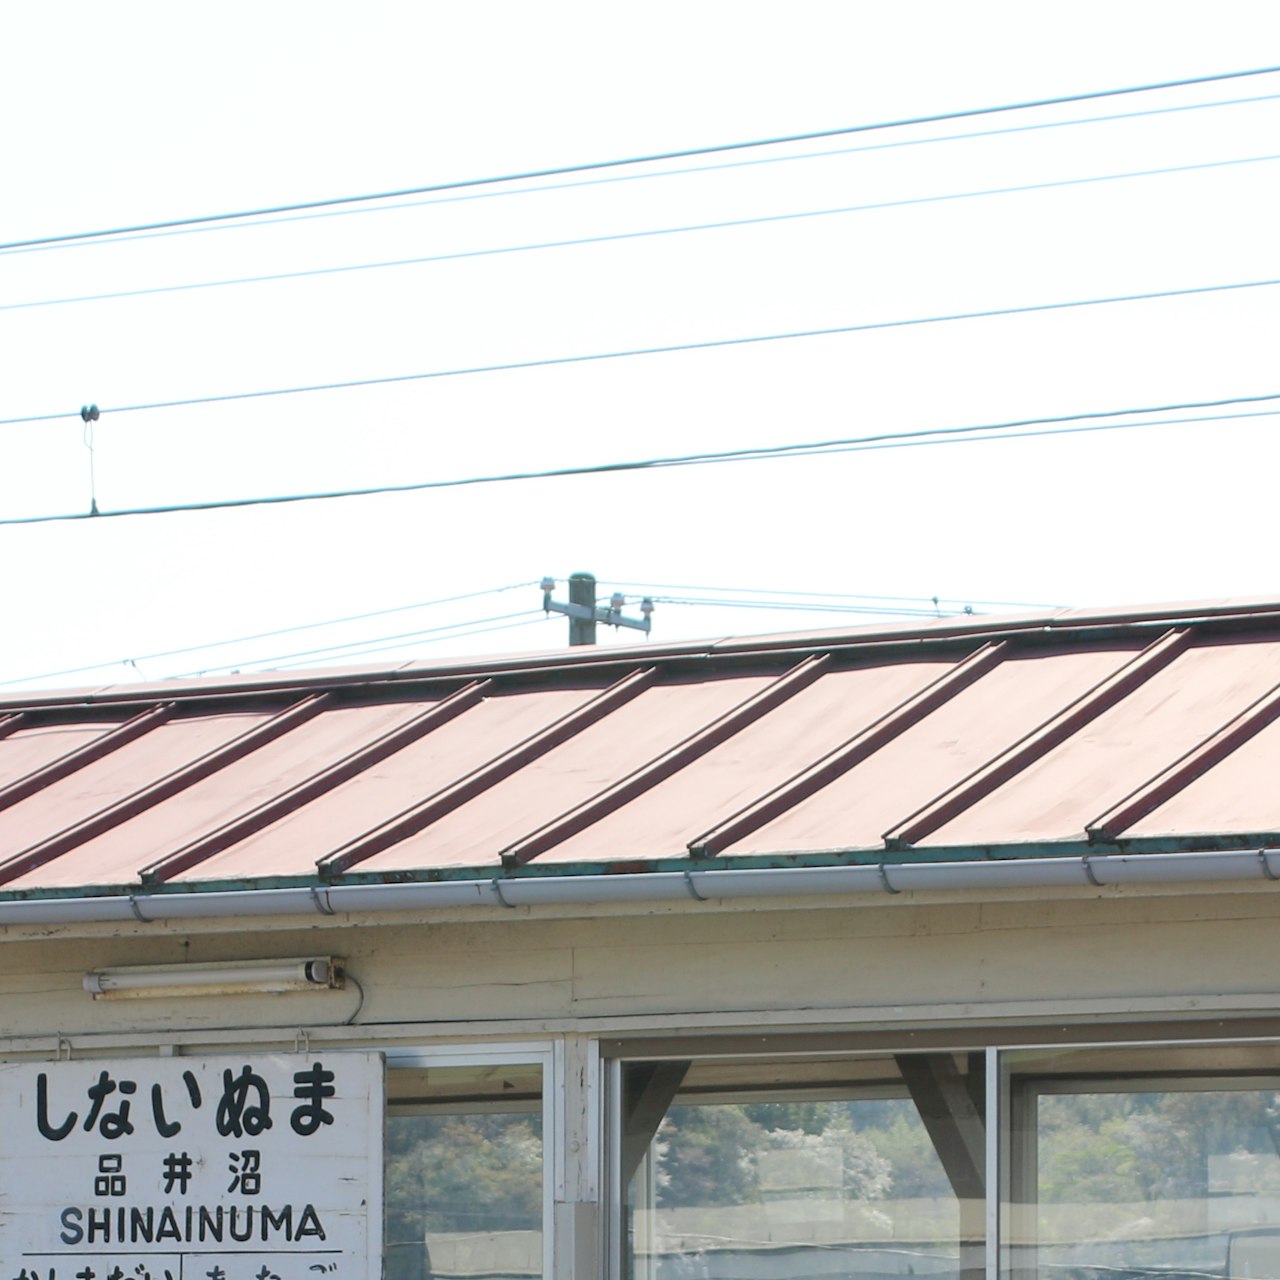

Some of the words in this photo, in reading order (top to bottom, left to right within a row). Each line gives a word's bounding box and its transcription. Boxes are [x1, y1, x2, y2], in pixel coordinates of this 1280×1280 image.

[36, 1061, 336, 1141] しないぬま
[94, 1149, 262, 1196] 品井沼
[60, 1203, 326, 1245] SHINAINUMA
